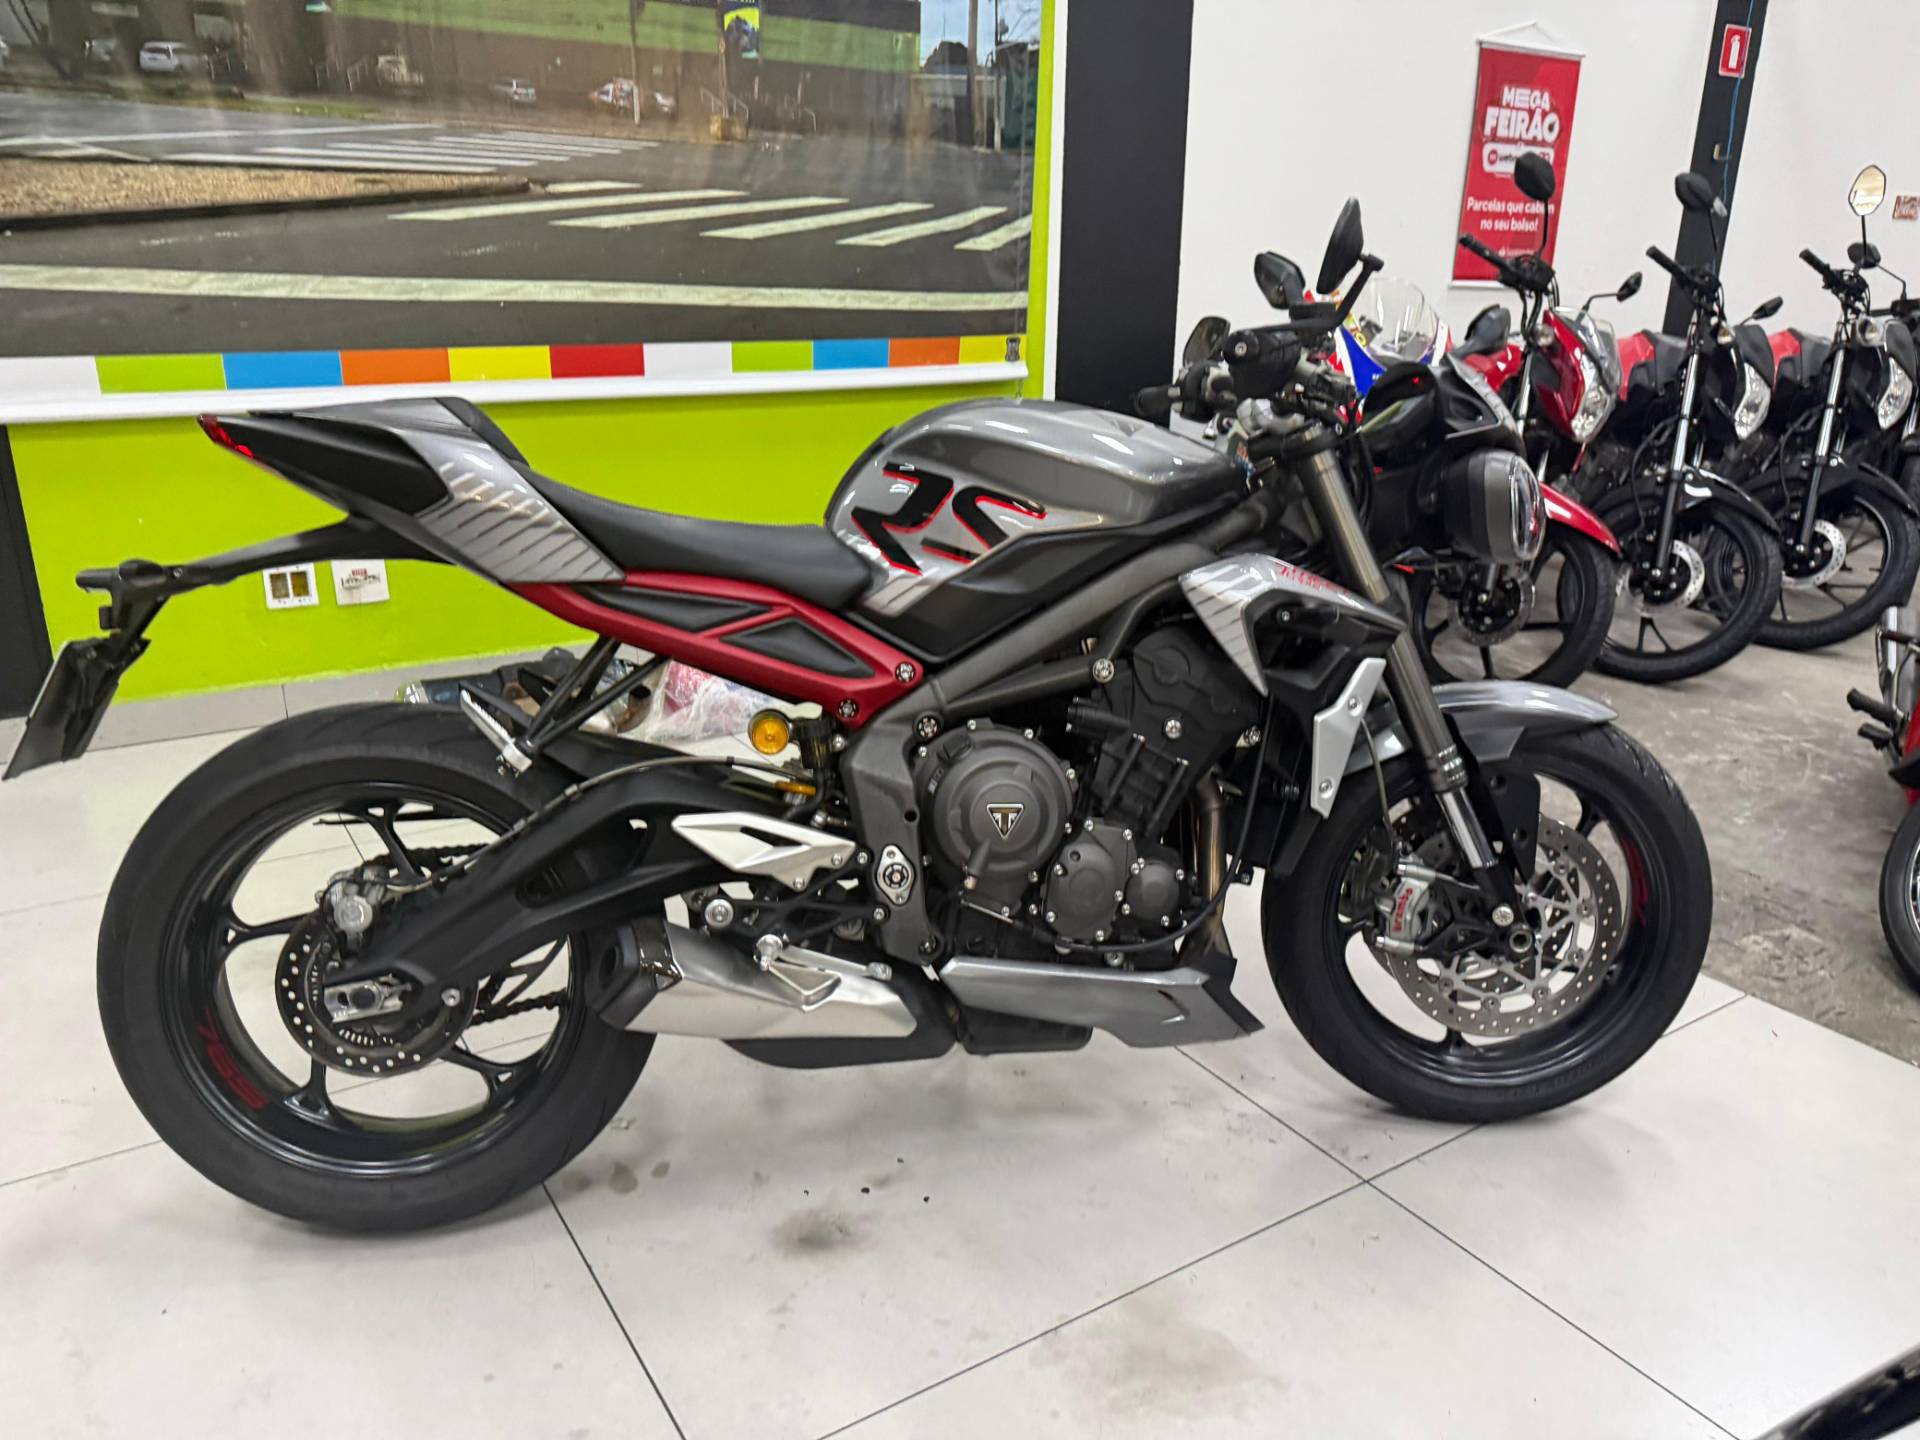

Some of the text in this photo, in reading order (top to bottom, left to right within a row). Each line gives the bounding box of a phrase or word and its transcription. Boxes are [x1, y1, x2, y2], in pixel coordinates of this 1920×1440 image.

[1502, 86, 1550, 111] MEGA
[1467, 196, 1505, 213] Parcelas
[1507, 202, 1524, 215] que
[1480, 217, 1538, 232] no seu bolso!
